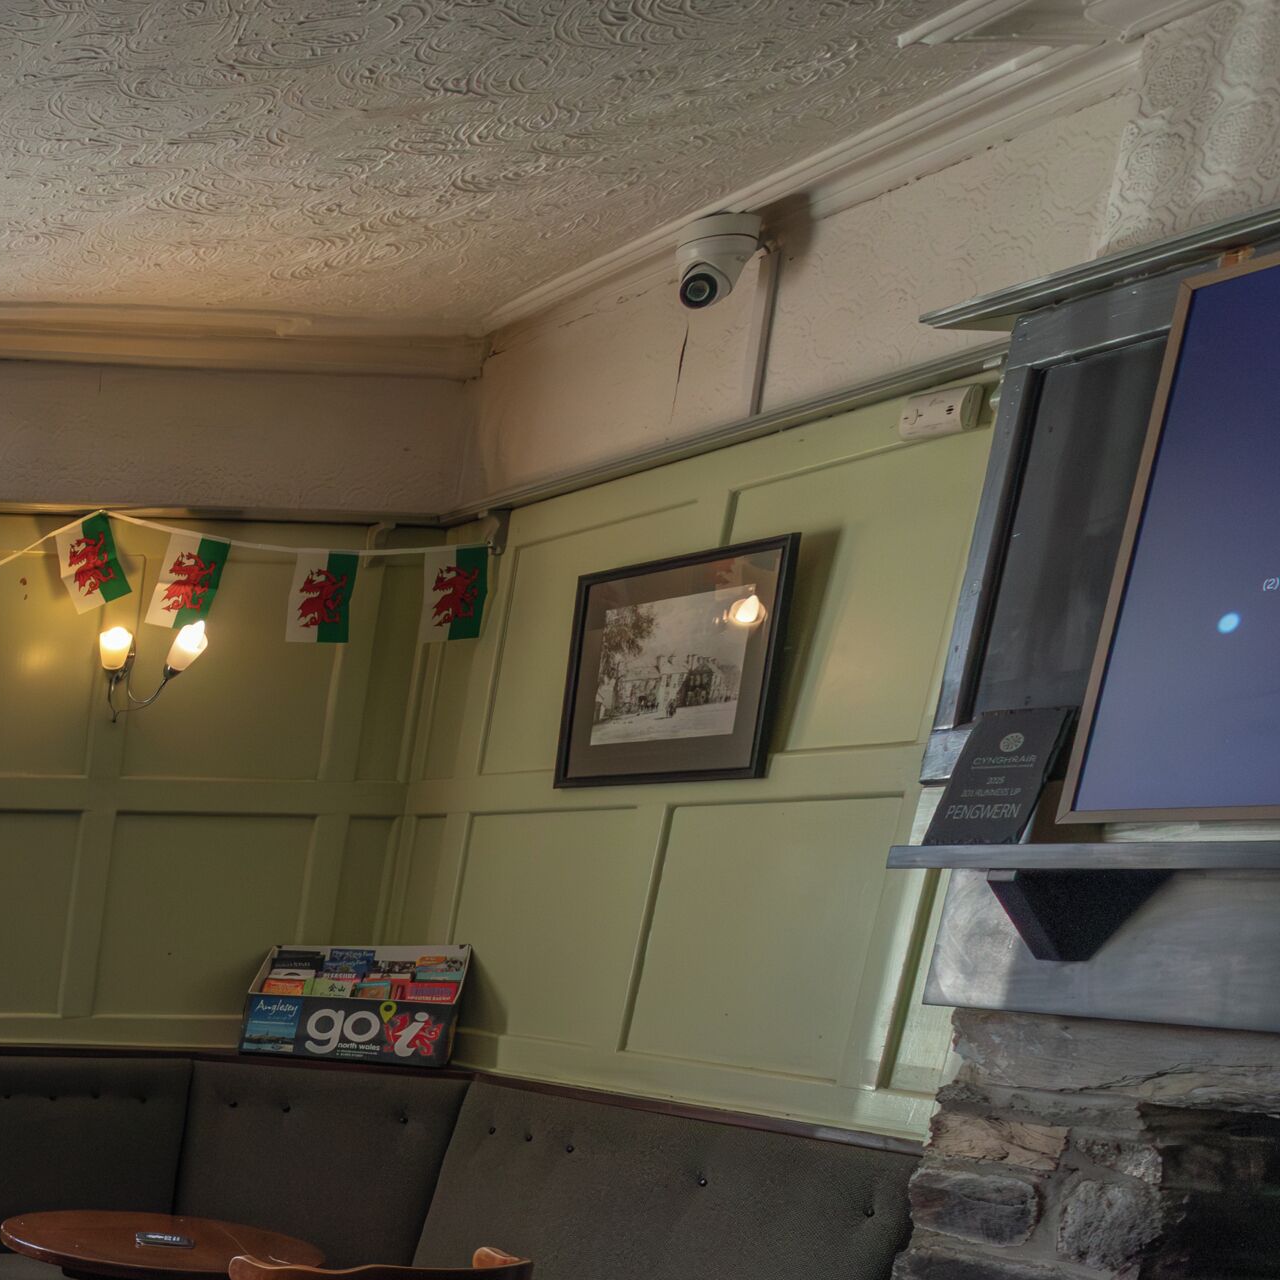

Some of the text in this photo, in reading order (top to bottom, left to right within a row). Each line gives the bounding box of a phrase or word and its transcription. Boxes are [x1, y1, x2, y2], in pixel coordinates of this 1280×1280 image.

[945, 803, 1022, 820] PENGWERN
[256, 999, 299, 1018] Anglesey
[304, 1007, 381, 1055] go
[337, 1042, 381, 1051] north wales
